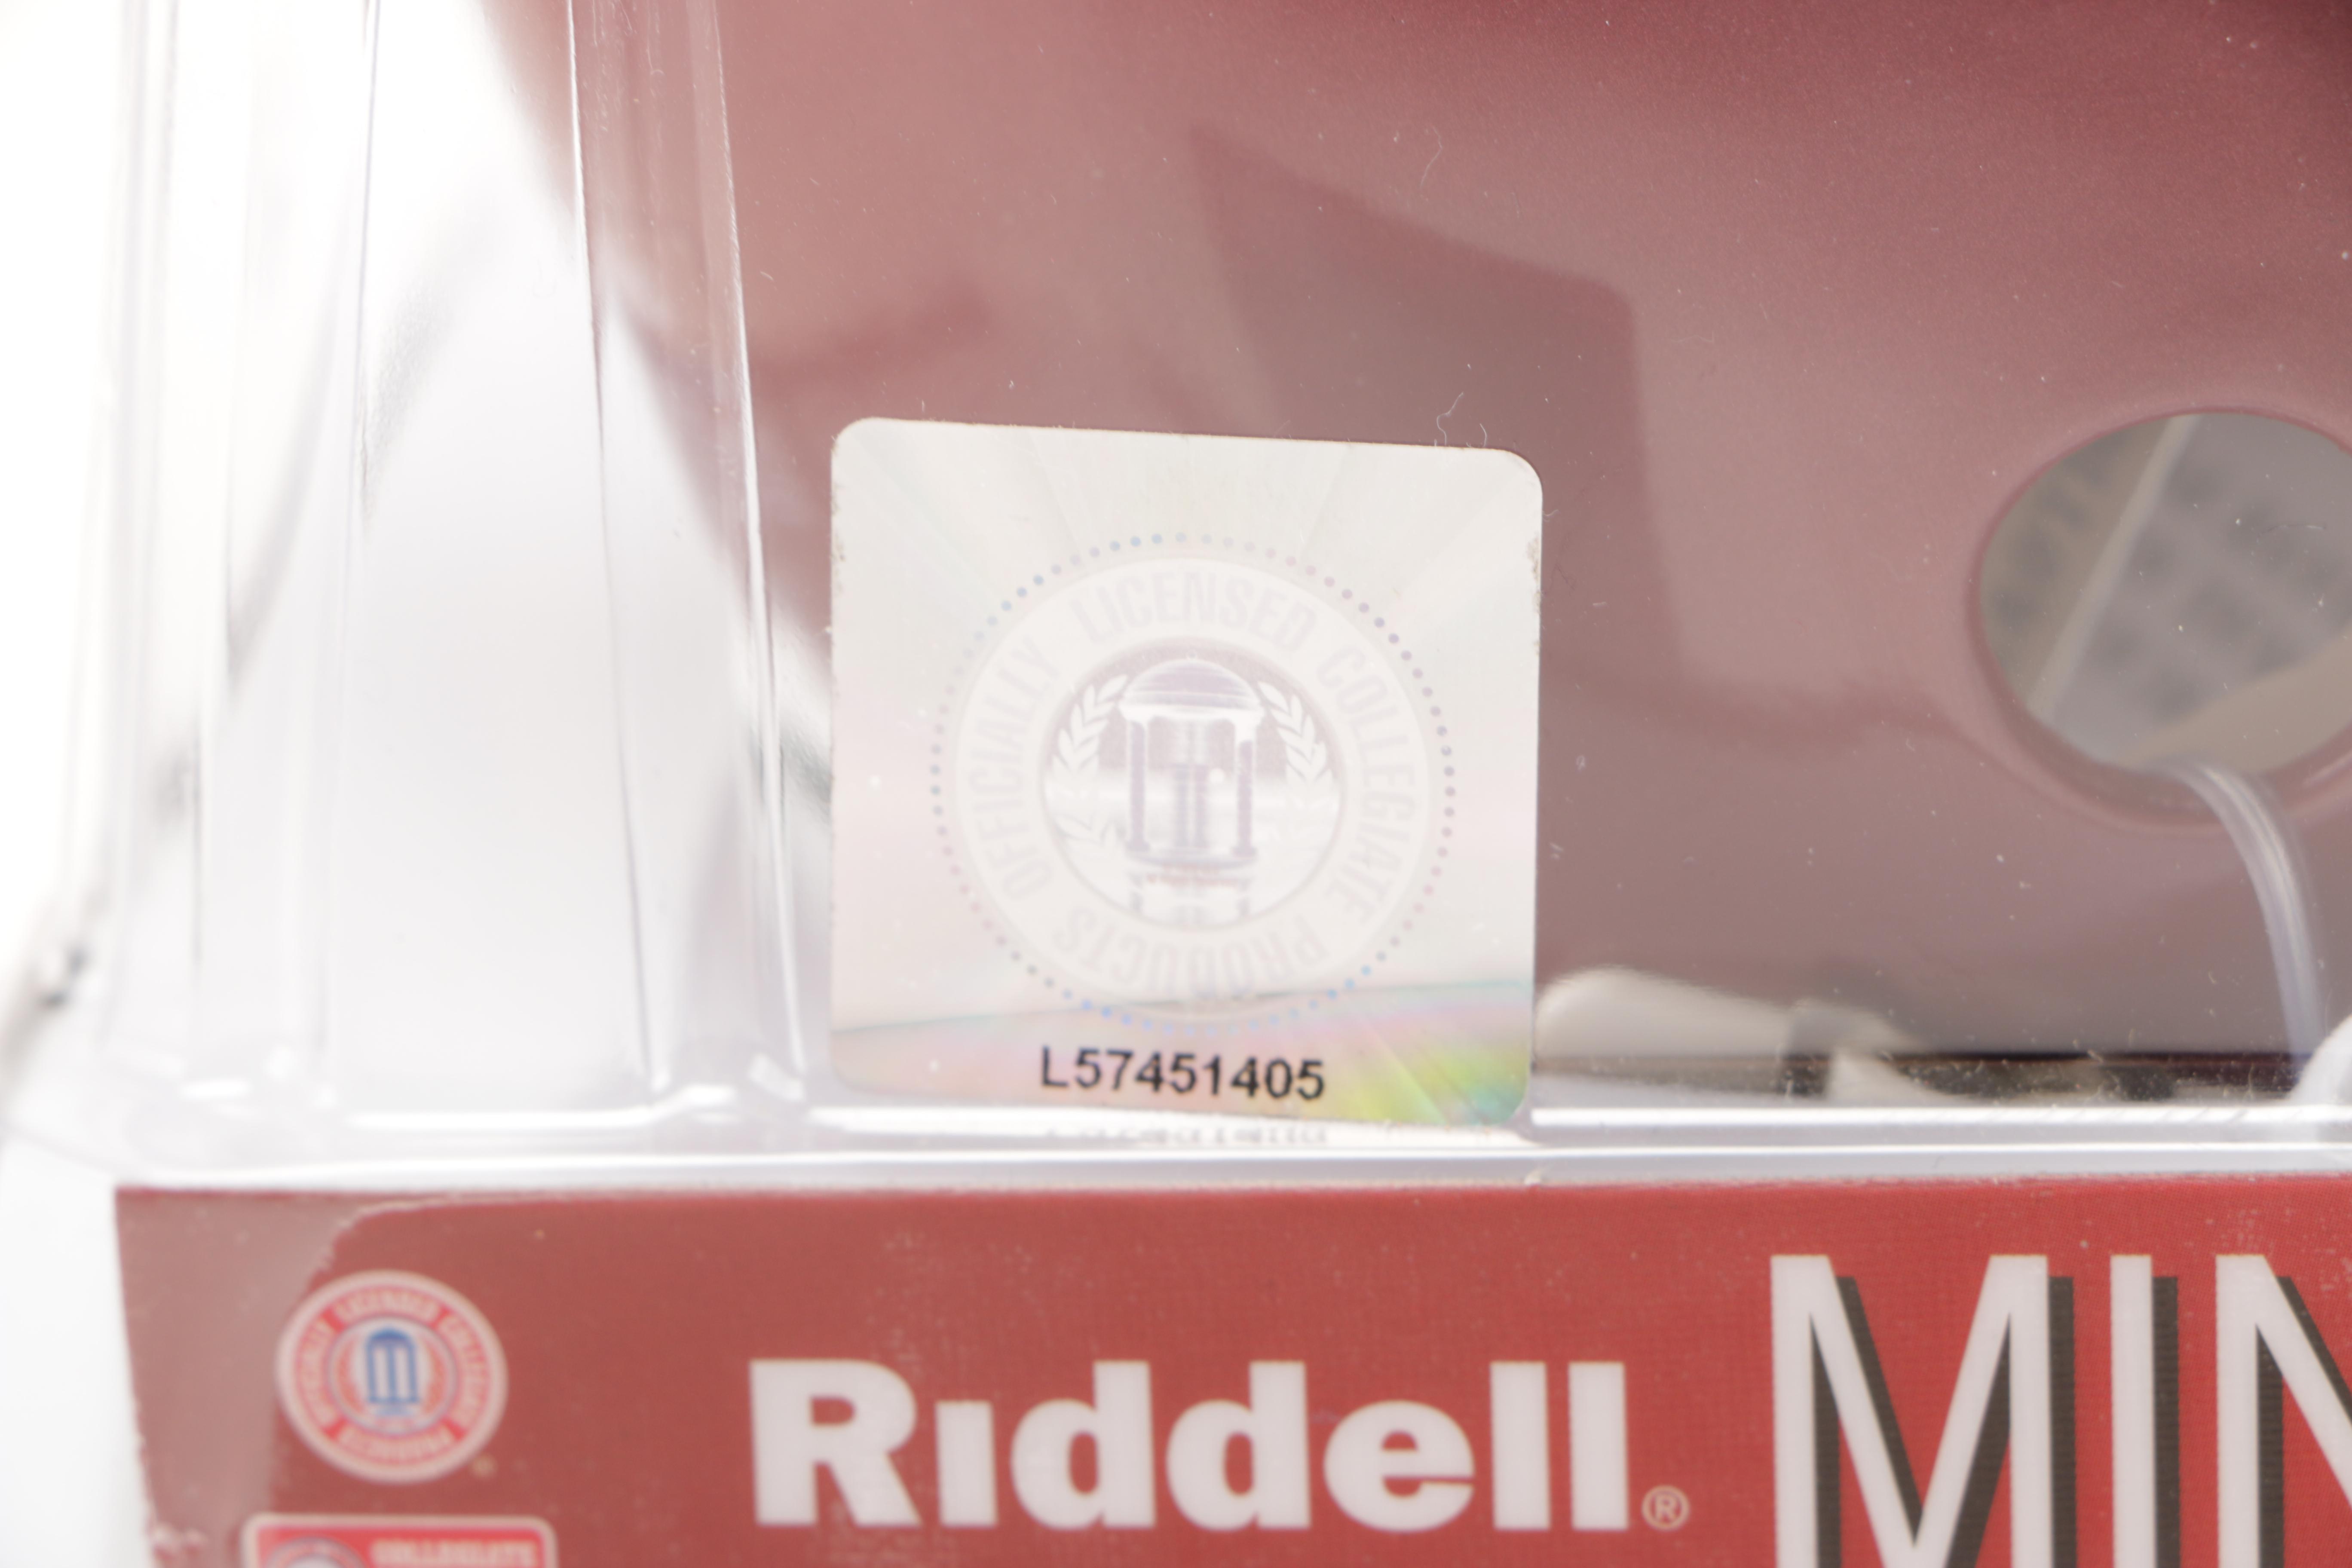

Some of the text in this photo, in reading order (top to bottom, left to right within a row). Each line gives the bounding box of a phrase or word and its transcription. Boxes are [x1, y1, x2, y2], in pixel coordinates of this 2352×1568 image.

[968, 570, 1418, 993] OFFICIALLY LICENSED COLLEGIATE PRODUCTS
[1041, 1045, 1325, 1100] L57451405
[749, 1360, 1629, 1531] Riddell
